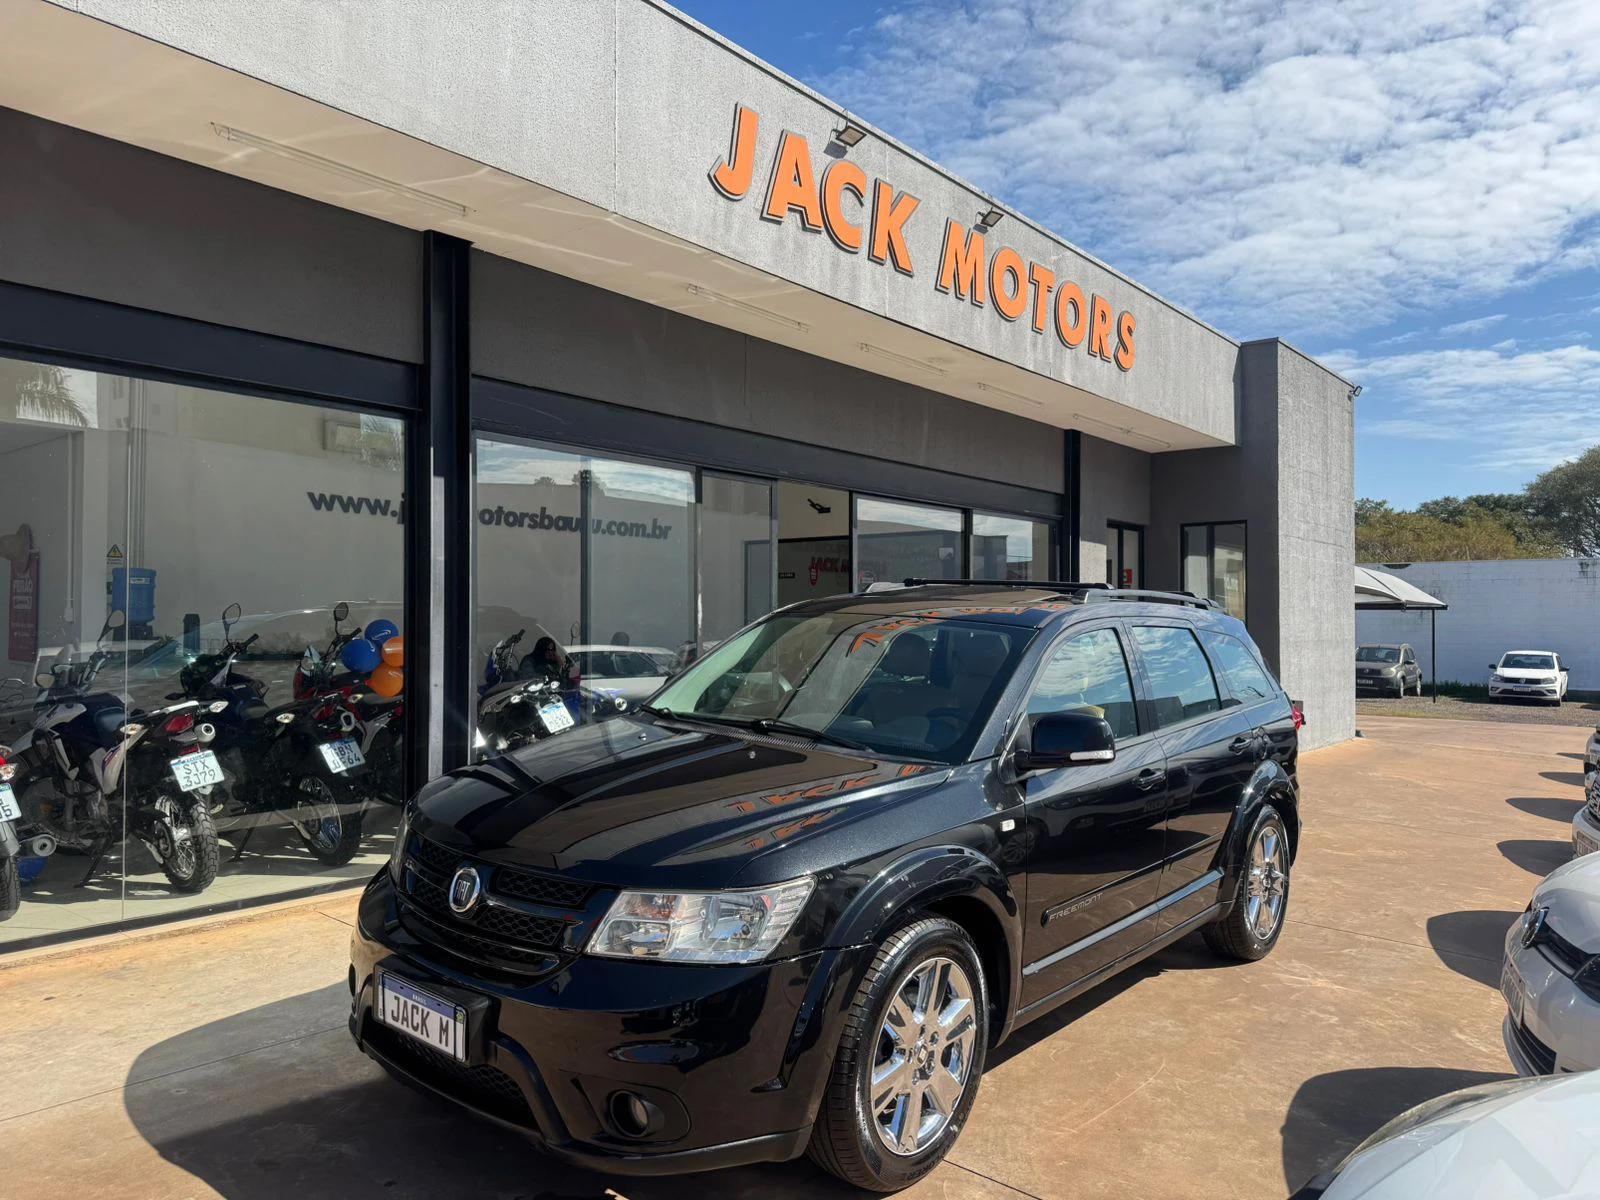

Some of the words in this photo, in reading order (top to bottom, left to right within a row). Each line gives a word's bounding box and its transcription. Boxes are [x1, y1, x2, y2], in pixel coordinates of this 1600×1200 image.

[707, 102, 922, 278] JACK
[935, 217, 1136, 372] MOTORS
[183, 759, 210, 775] STX
[1048, 892, 1104, 921] FREEMONT
[391, 995, 430, 1038] JACK
[439, 1016, 450, 1048] M
